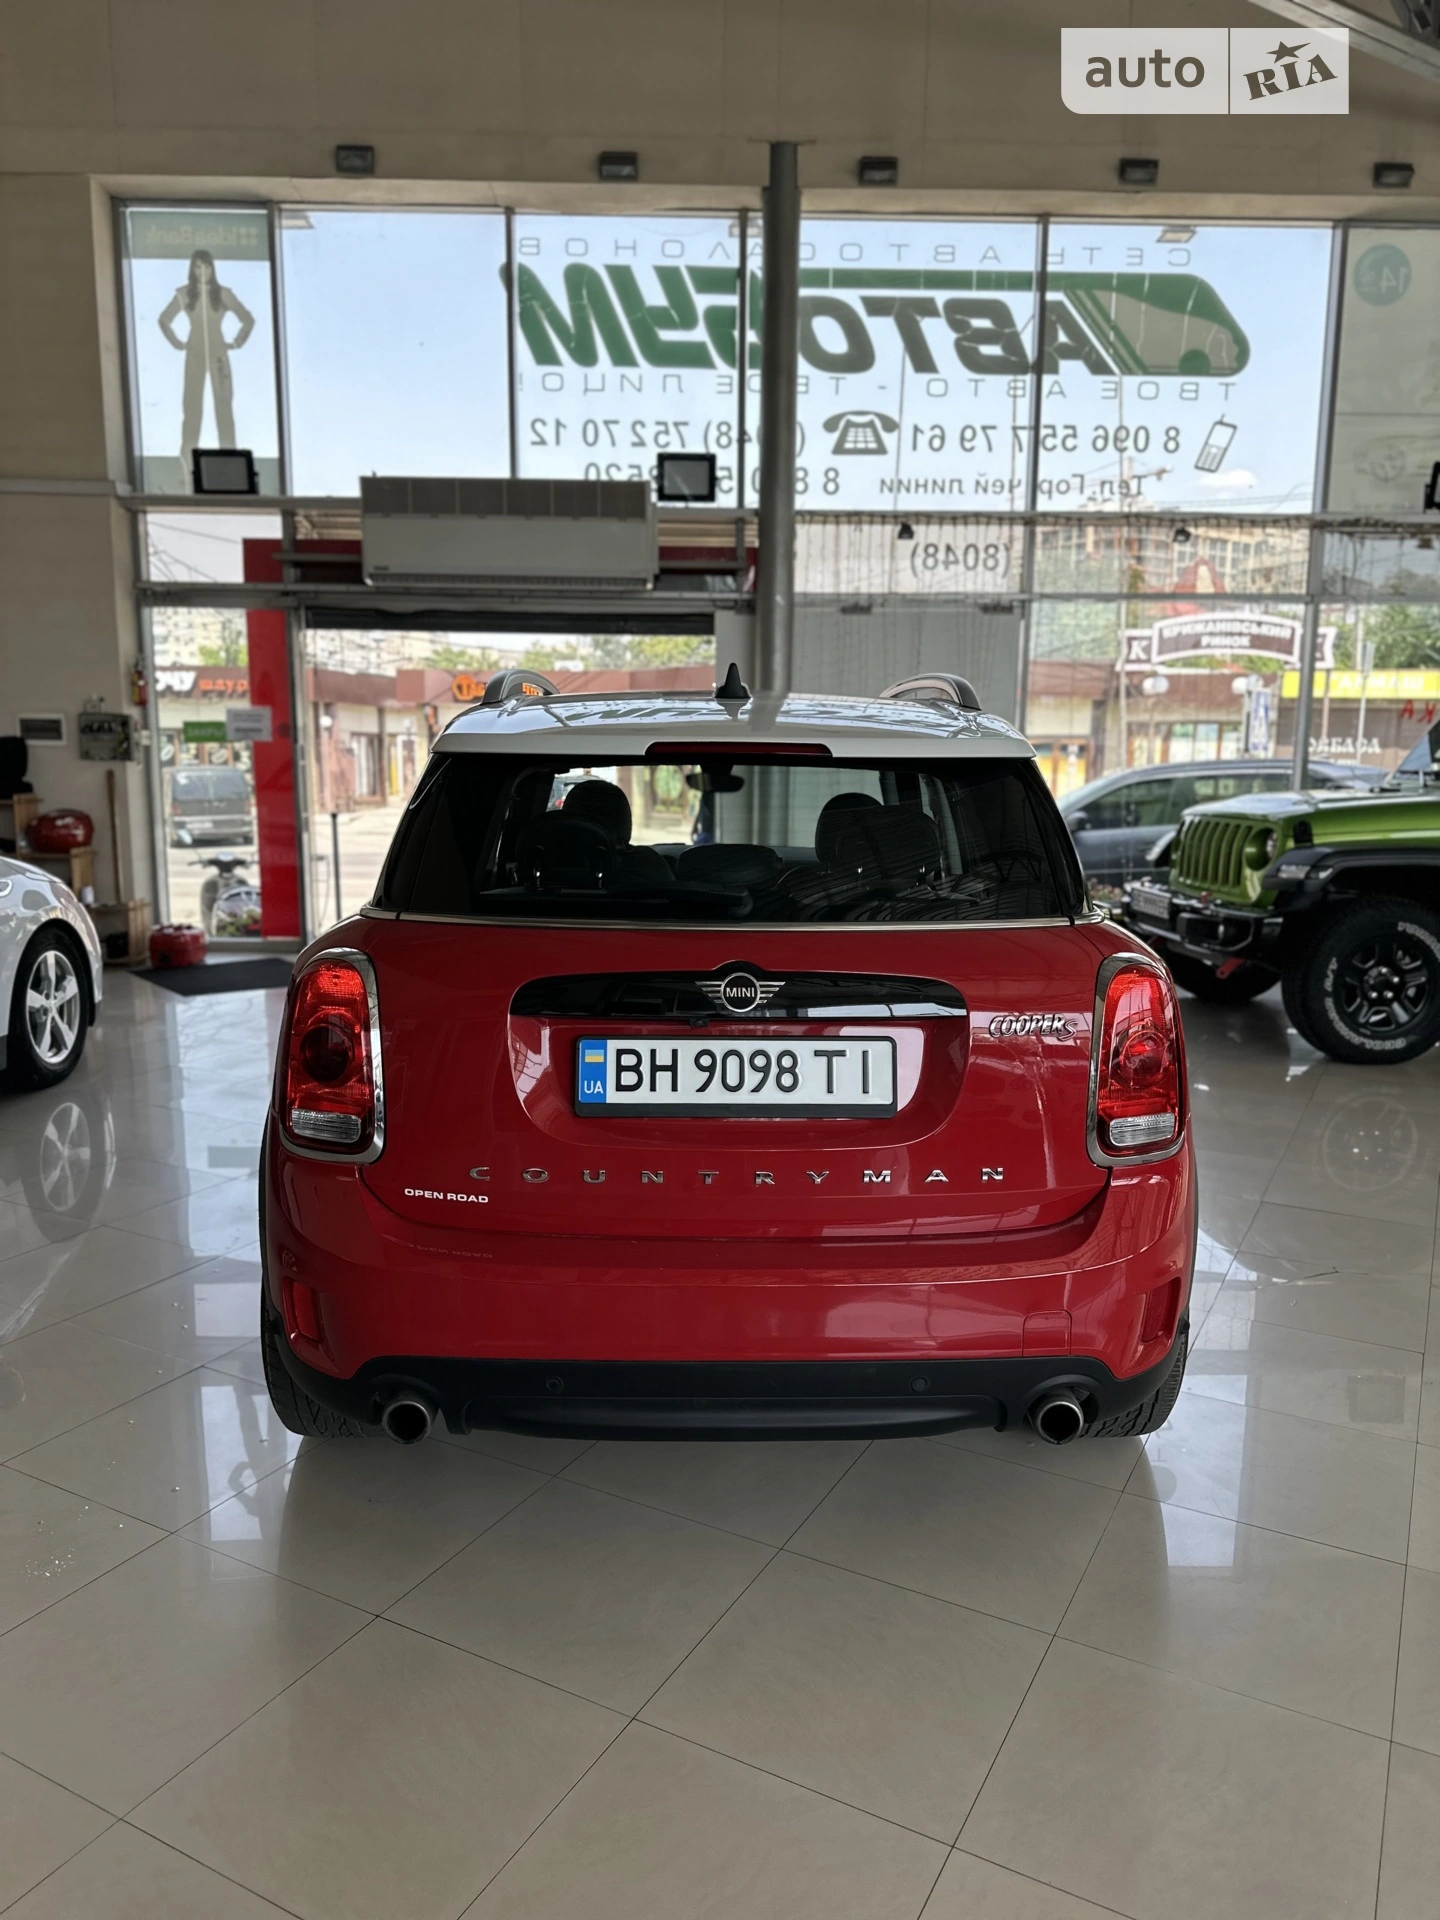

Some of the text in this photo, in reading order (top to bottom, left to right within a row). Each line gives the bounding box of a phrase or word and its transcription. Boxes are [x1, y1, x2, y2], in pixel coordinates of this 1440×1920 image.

[1201, 635, 1251, 648] РИНОК
[726, 986, 756, 998] MINI
[615, 1048, 679, 1093] BH
[694, 1049, 801, 1093] 9098
[584, 1080, 604, 1094] UA
[469, 1166, 1005, 1188] COUNTRYMAN
[404, 1188, 489, 1204] OPEN ROAD
